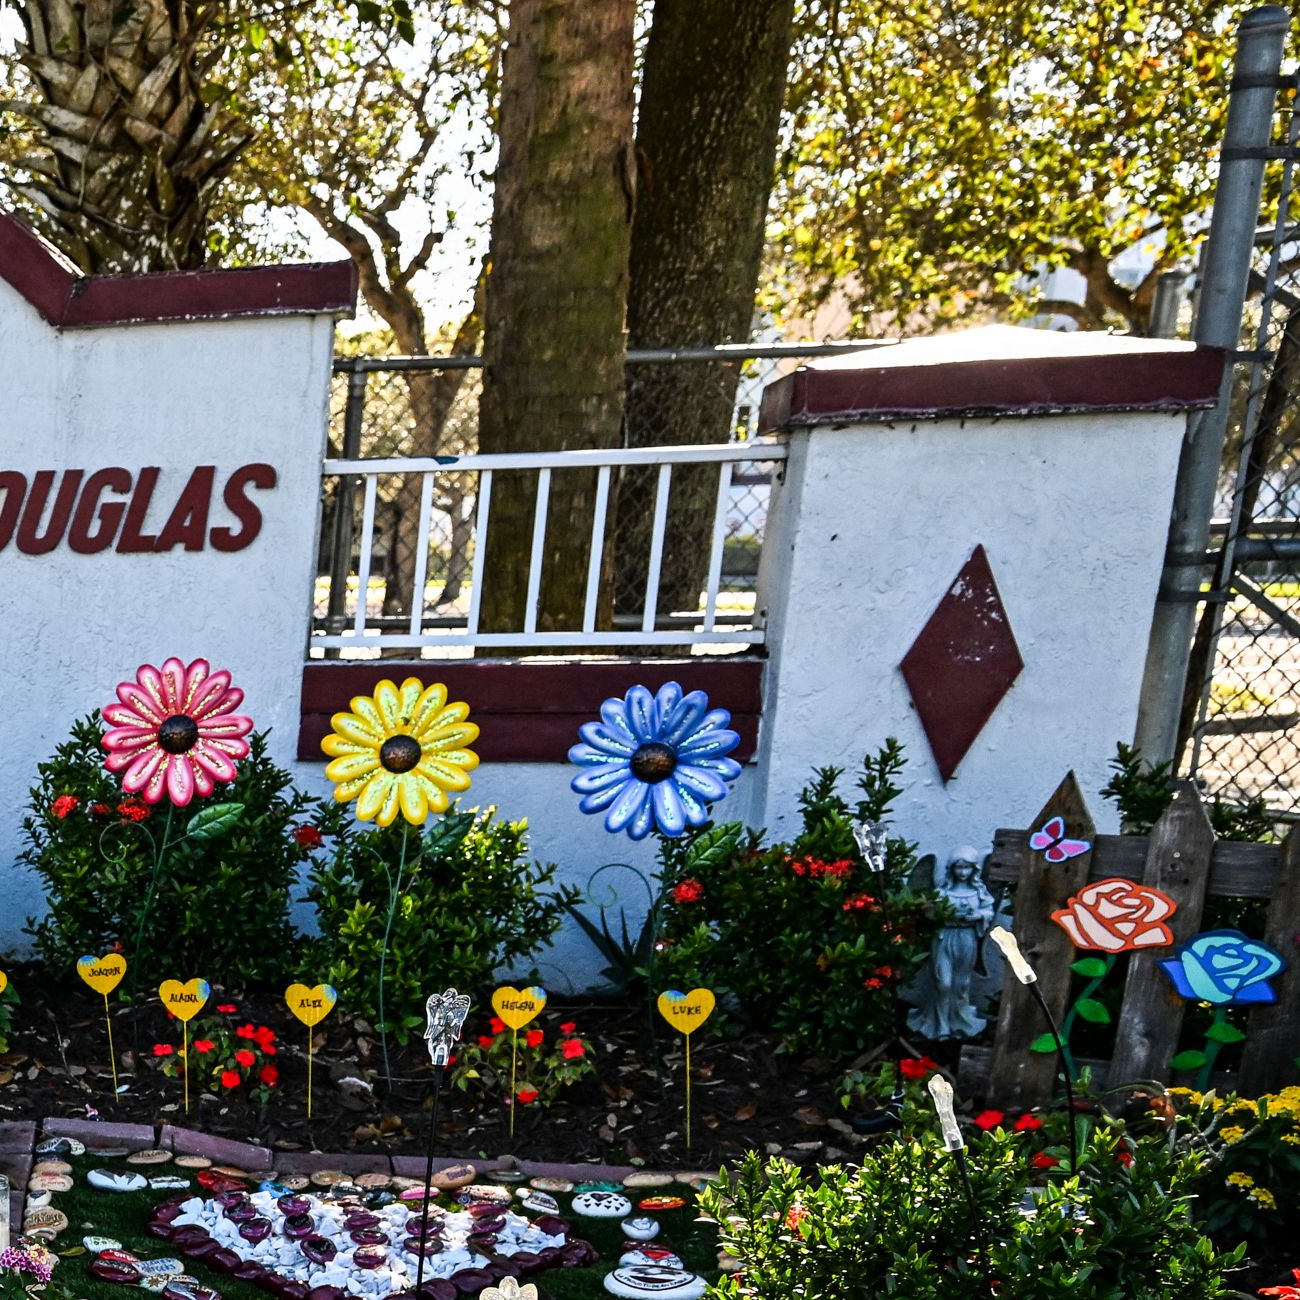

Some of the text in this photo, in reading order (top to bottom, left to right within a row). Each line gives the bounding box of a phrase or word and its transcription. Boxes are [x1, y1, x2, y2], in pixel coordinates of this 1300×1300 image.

[88, 967, 120, 978] JOAQUIN
[169, 993, 199, 1003] ALAINA
[299, 999, 322, 1008] ALEX
[501, 1000, 535, 1012] HELENA
[672, 1005, 701, 1015] LUKE
